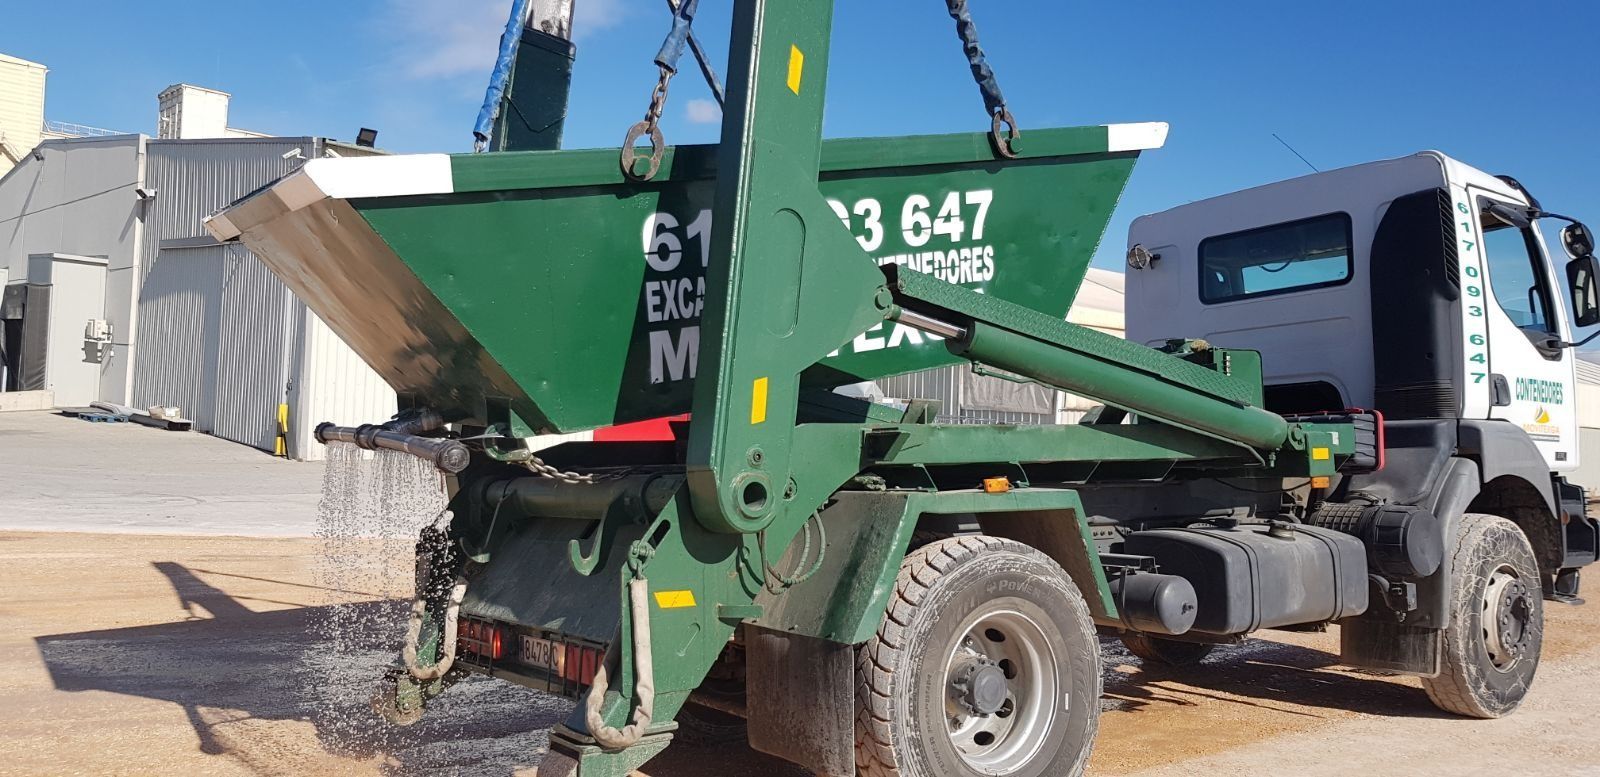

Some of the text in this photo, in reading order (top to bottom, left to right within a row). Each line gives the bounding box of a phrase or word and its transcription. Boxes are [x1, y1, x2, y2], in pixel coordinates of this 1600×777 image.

[642, 209, 712, 272] 61
[902, 189, 993, 247] 647
[1457, 202, 1486, 384] 617 093 647
[1515, 377, 1564, 405] CONTENEDORES
[525, 639, 550, 665] 8478
